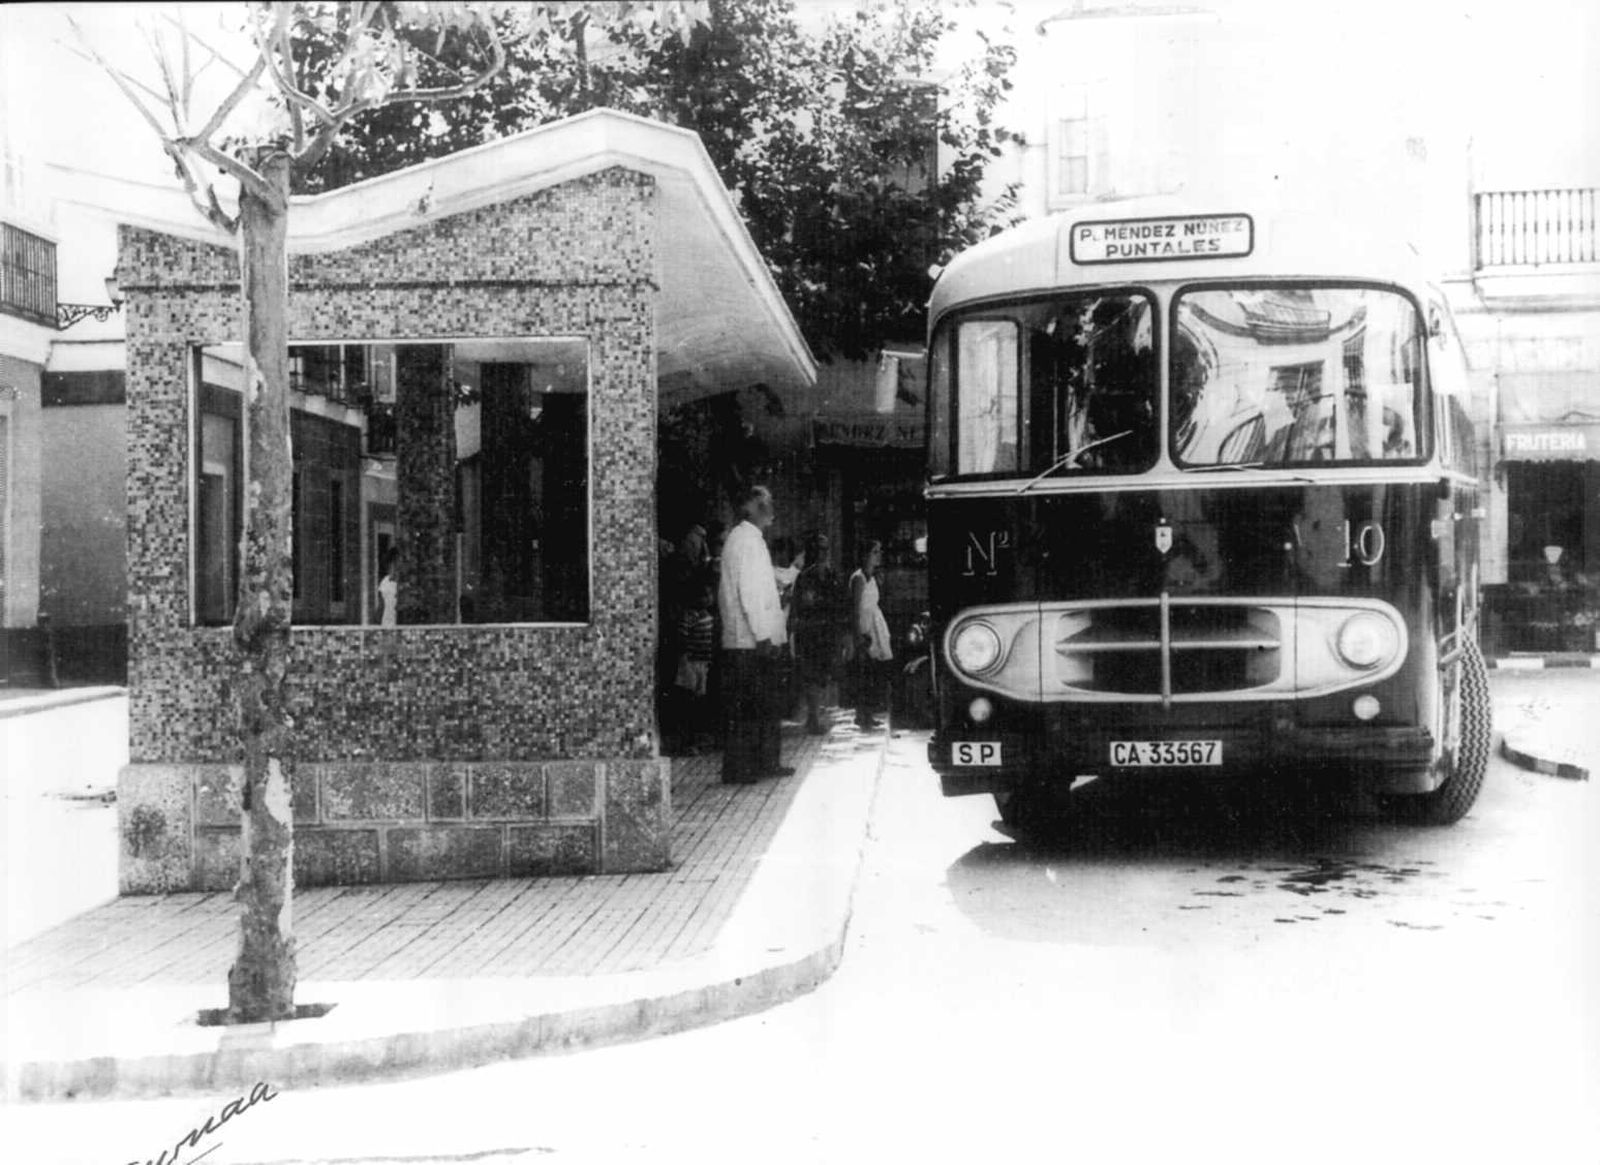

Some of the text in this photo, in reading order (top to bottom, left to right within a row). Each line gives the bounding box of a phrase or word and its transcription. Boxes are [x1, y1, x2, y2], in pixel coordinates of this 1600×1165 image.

[1105, 238, 1221, 258] PUNTALES
[1505, 432, 1585, 451] FRUTERIA
[1336, 519, 1385, 567] 10
